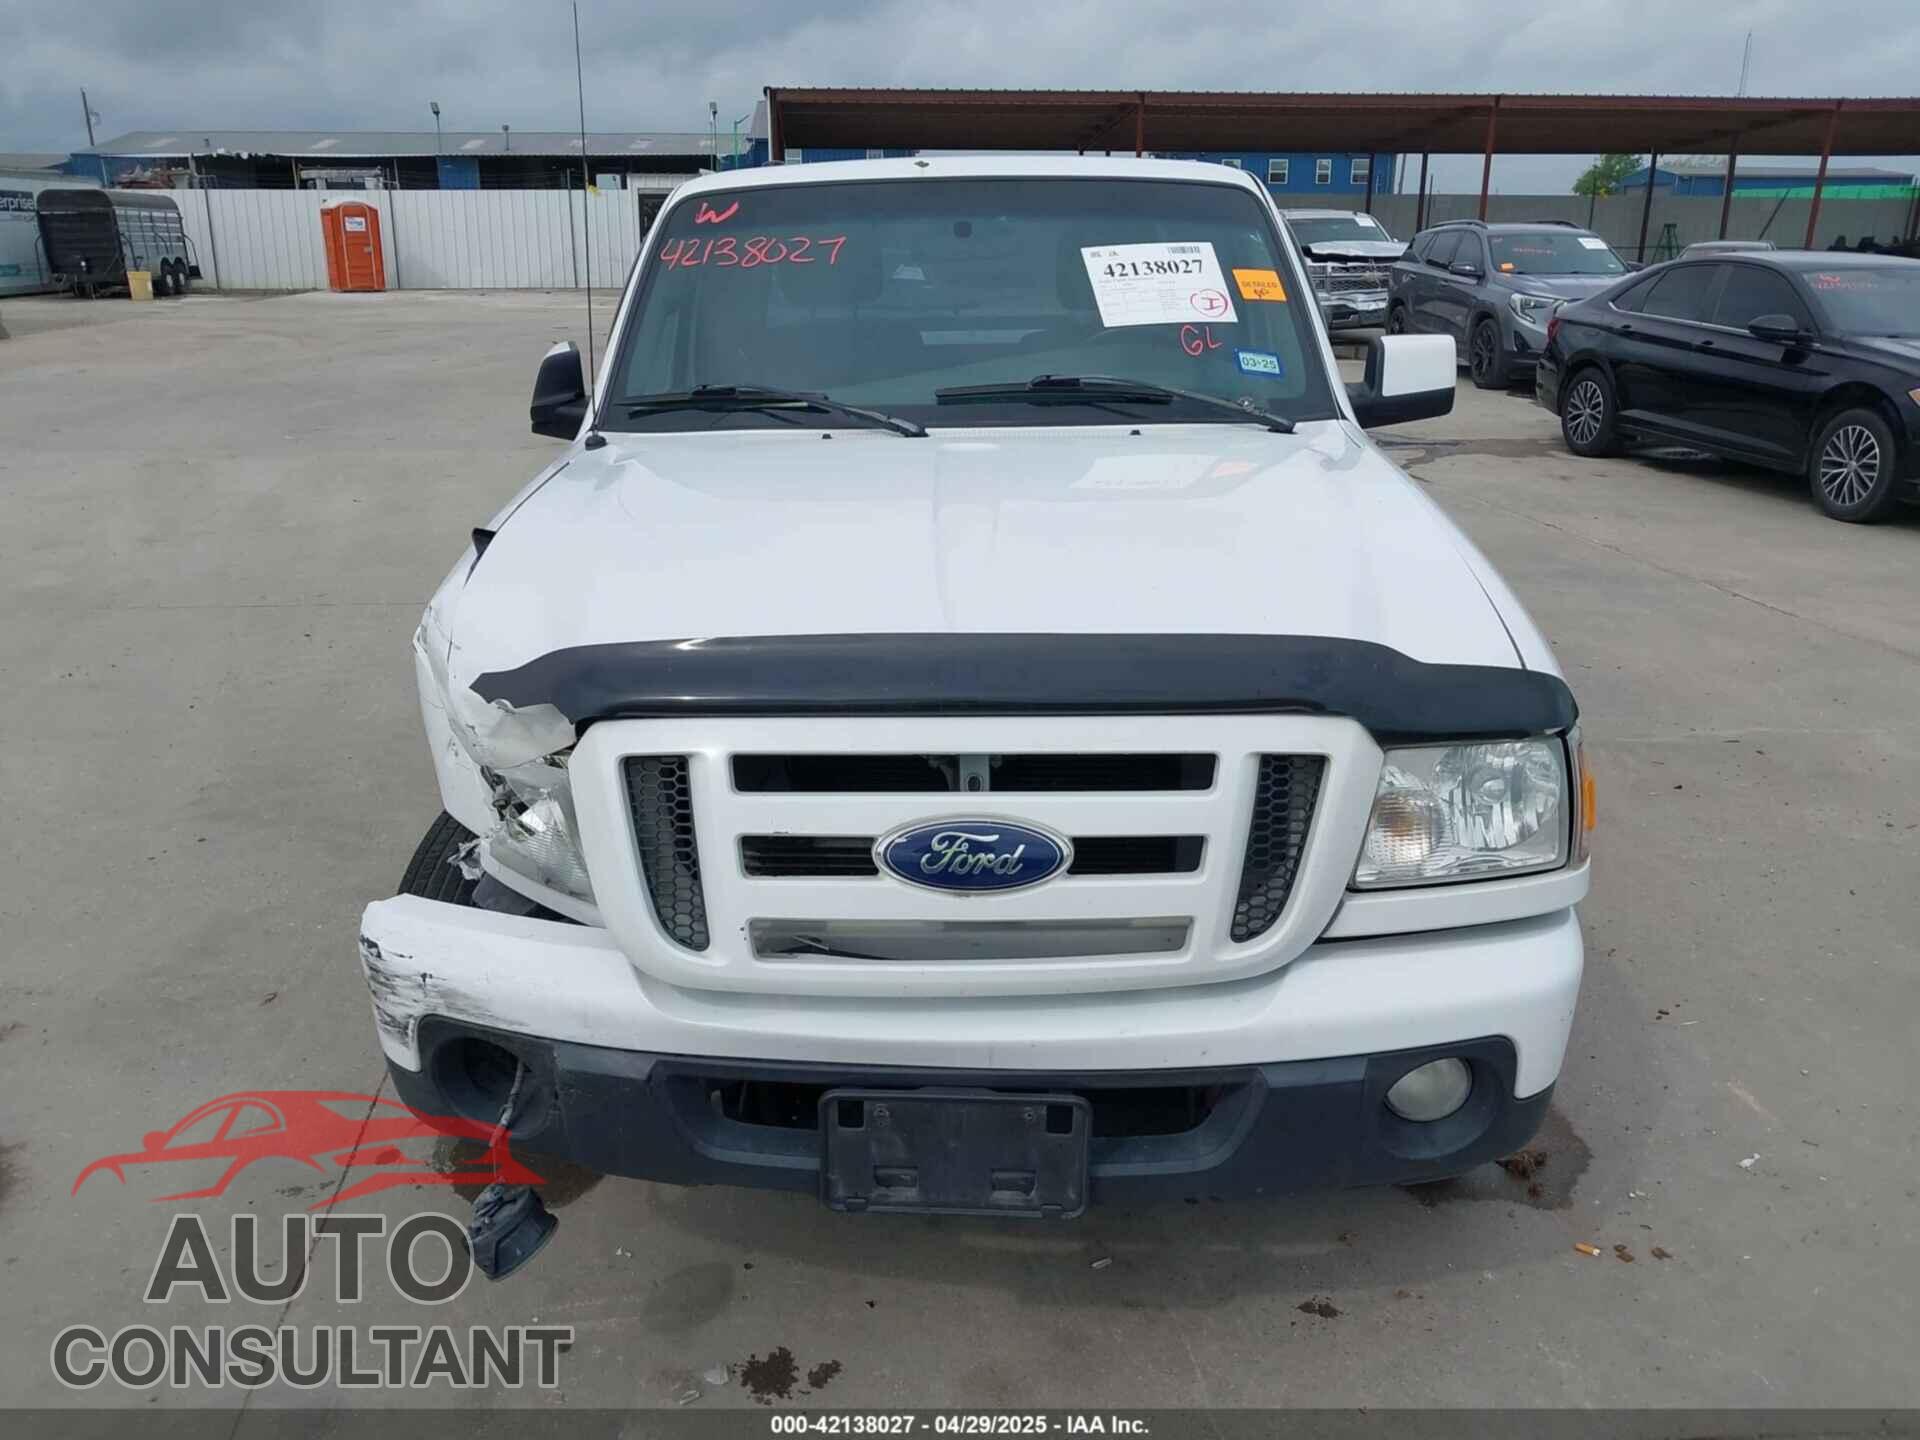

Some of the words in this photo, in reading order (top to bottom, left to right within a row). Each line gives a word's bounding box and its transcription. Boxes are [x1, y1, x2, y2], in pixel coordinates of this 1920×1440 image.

[659, 235, 848, 270] 42138027
[1103, 258, 1203, 278] 42138027
[919, 831, 1026, 876] Ford
